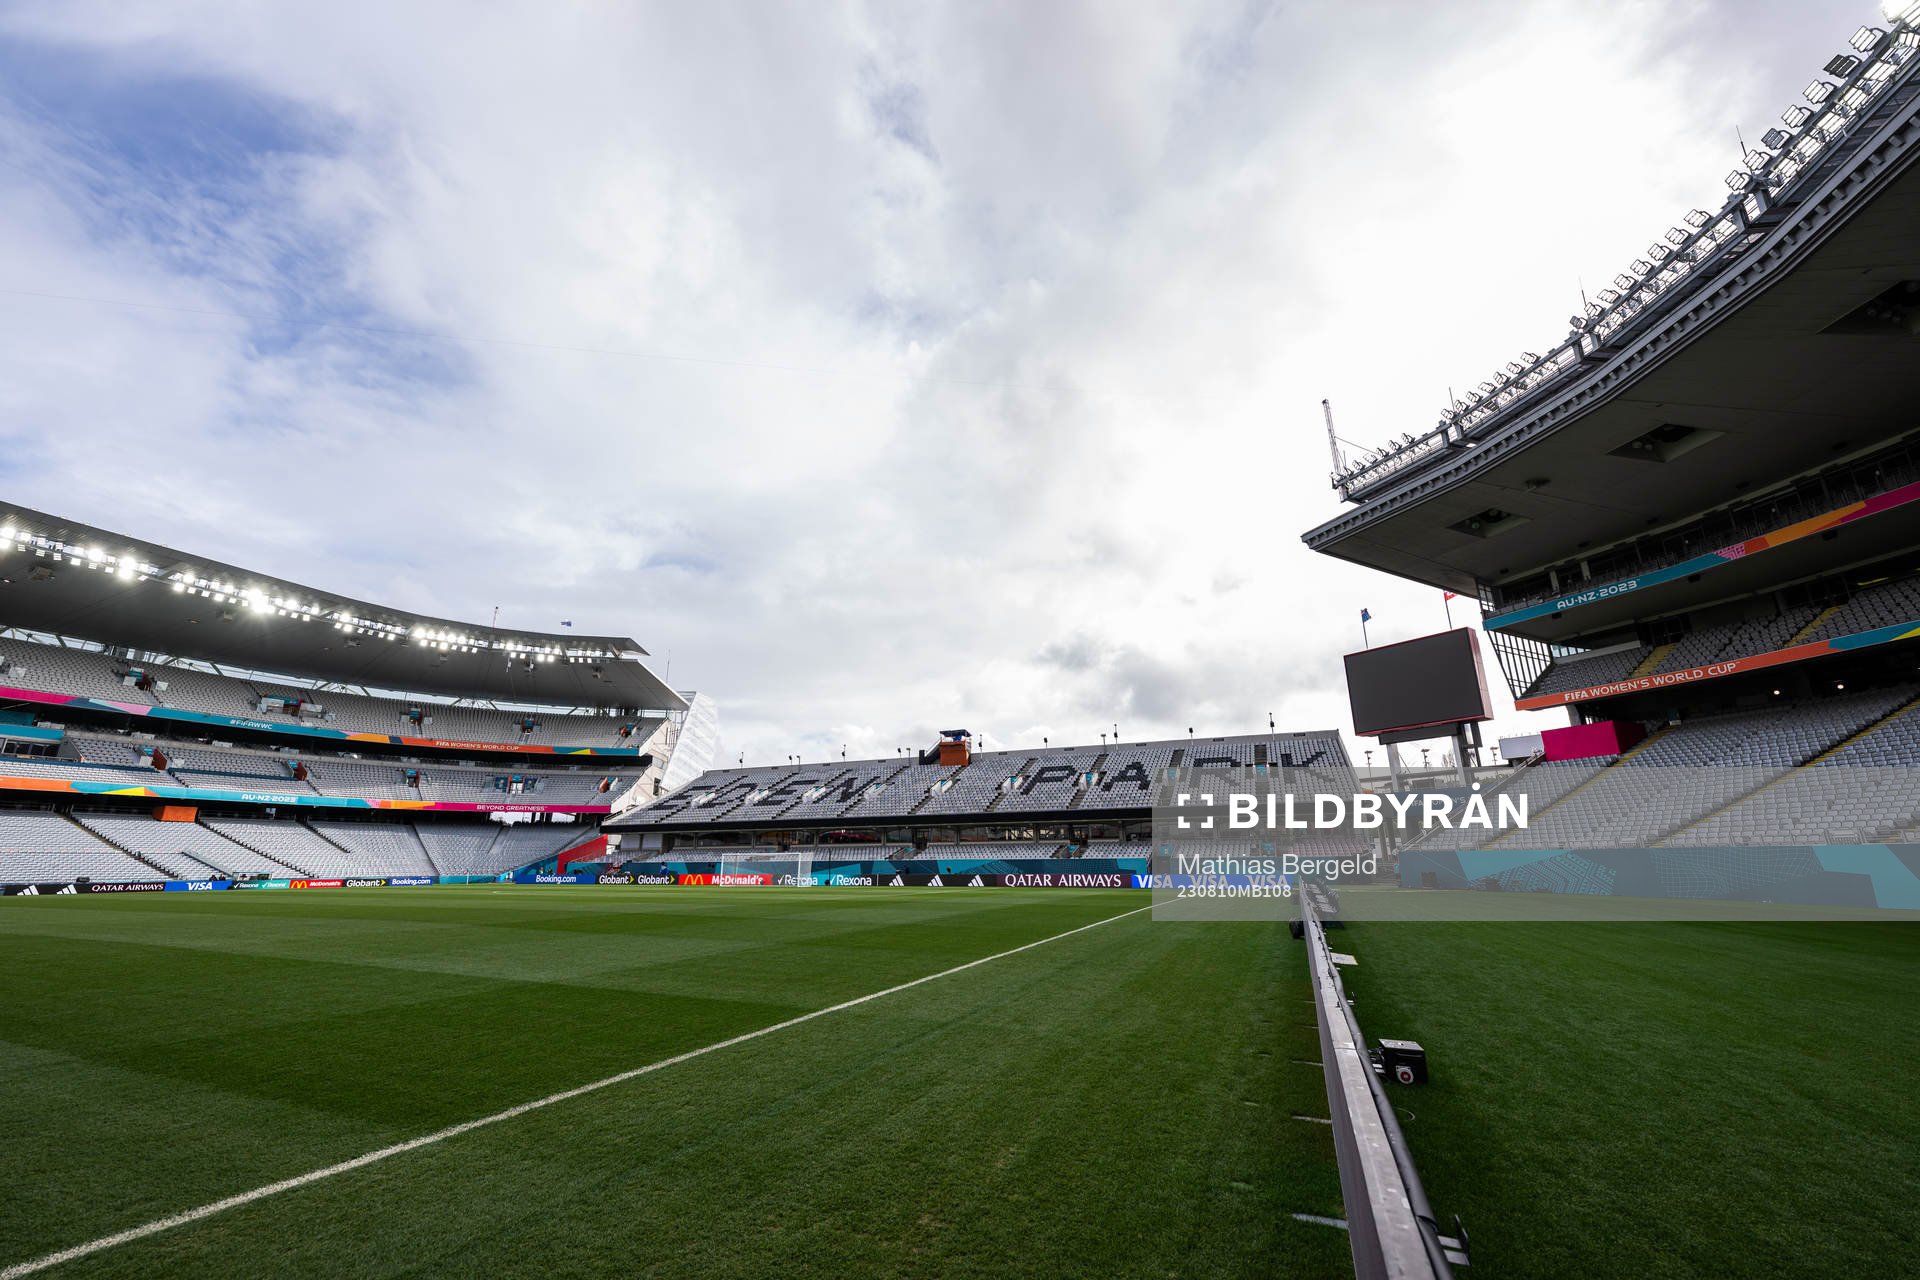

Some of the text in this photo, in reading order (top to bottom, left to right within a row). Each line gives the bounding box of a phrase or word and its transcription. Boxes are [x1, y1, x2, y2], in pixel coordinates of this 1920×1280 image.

[1564, 691, 1588, 701] FIFA
[1589, 679, 1650, 697] WOMEN'S
[1652, 669, 1704, 686] WORLD
[229, 719, 273, 730] #FIFAWWC
[346, 879, 380, 888] Globant
[391, 878, 431, 886] Booking.com
[535, 874, 577, 884] Booking.com
[599, 875, 629, 885] Globant
[637, 875, 670, 885] Globant
[836, 874, 872, 886] Rexona
[1005, 874, 1121, 888] QATAR AIRWAYS
[1135, 874, 1173, 889] VISA
[1188, 874, 1229, 889] VISA
[1246, 874, 1289, 889] VISA
[92, 883, 164, 893] QATAR AIRWAYS
[186, 882, 213, 891] VISA
